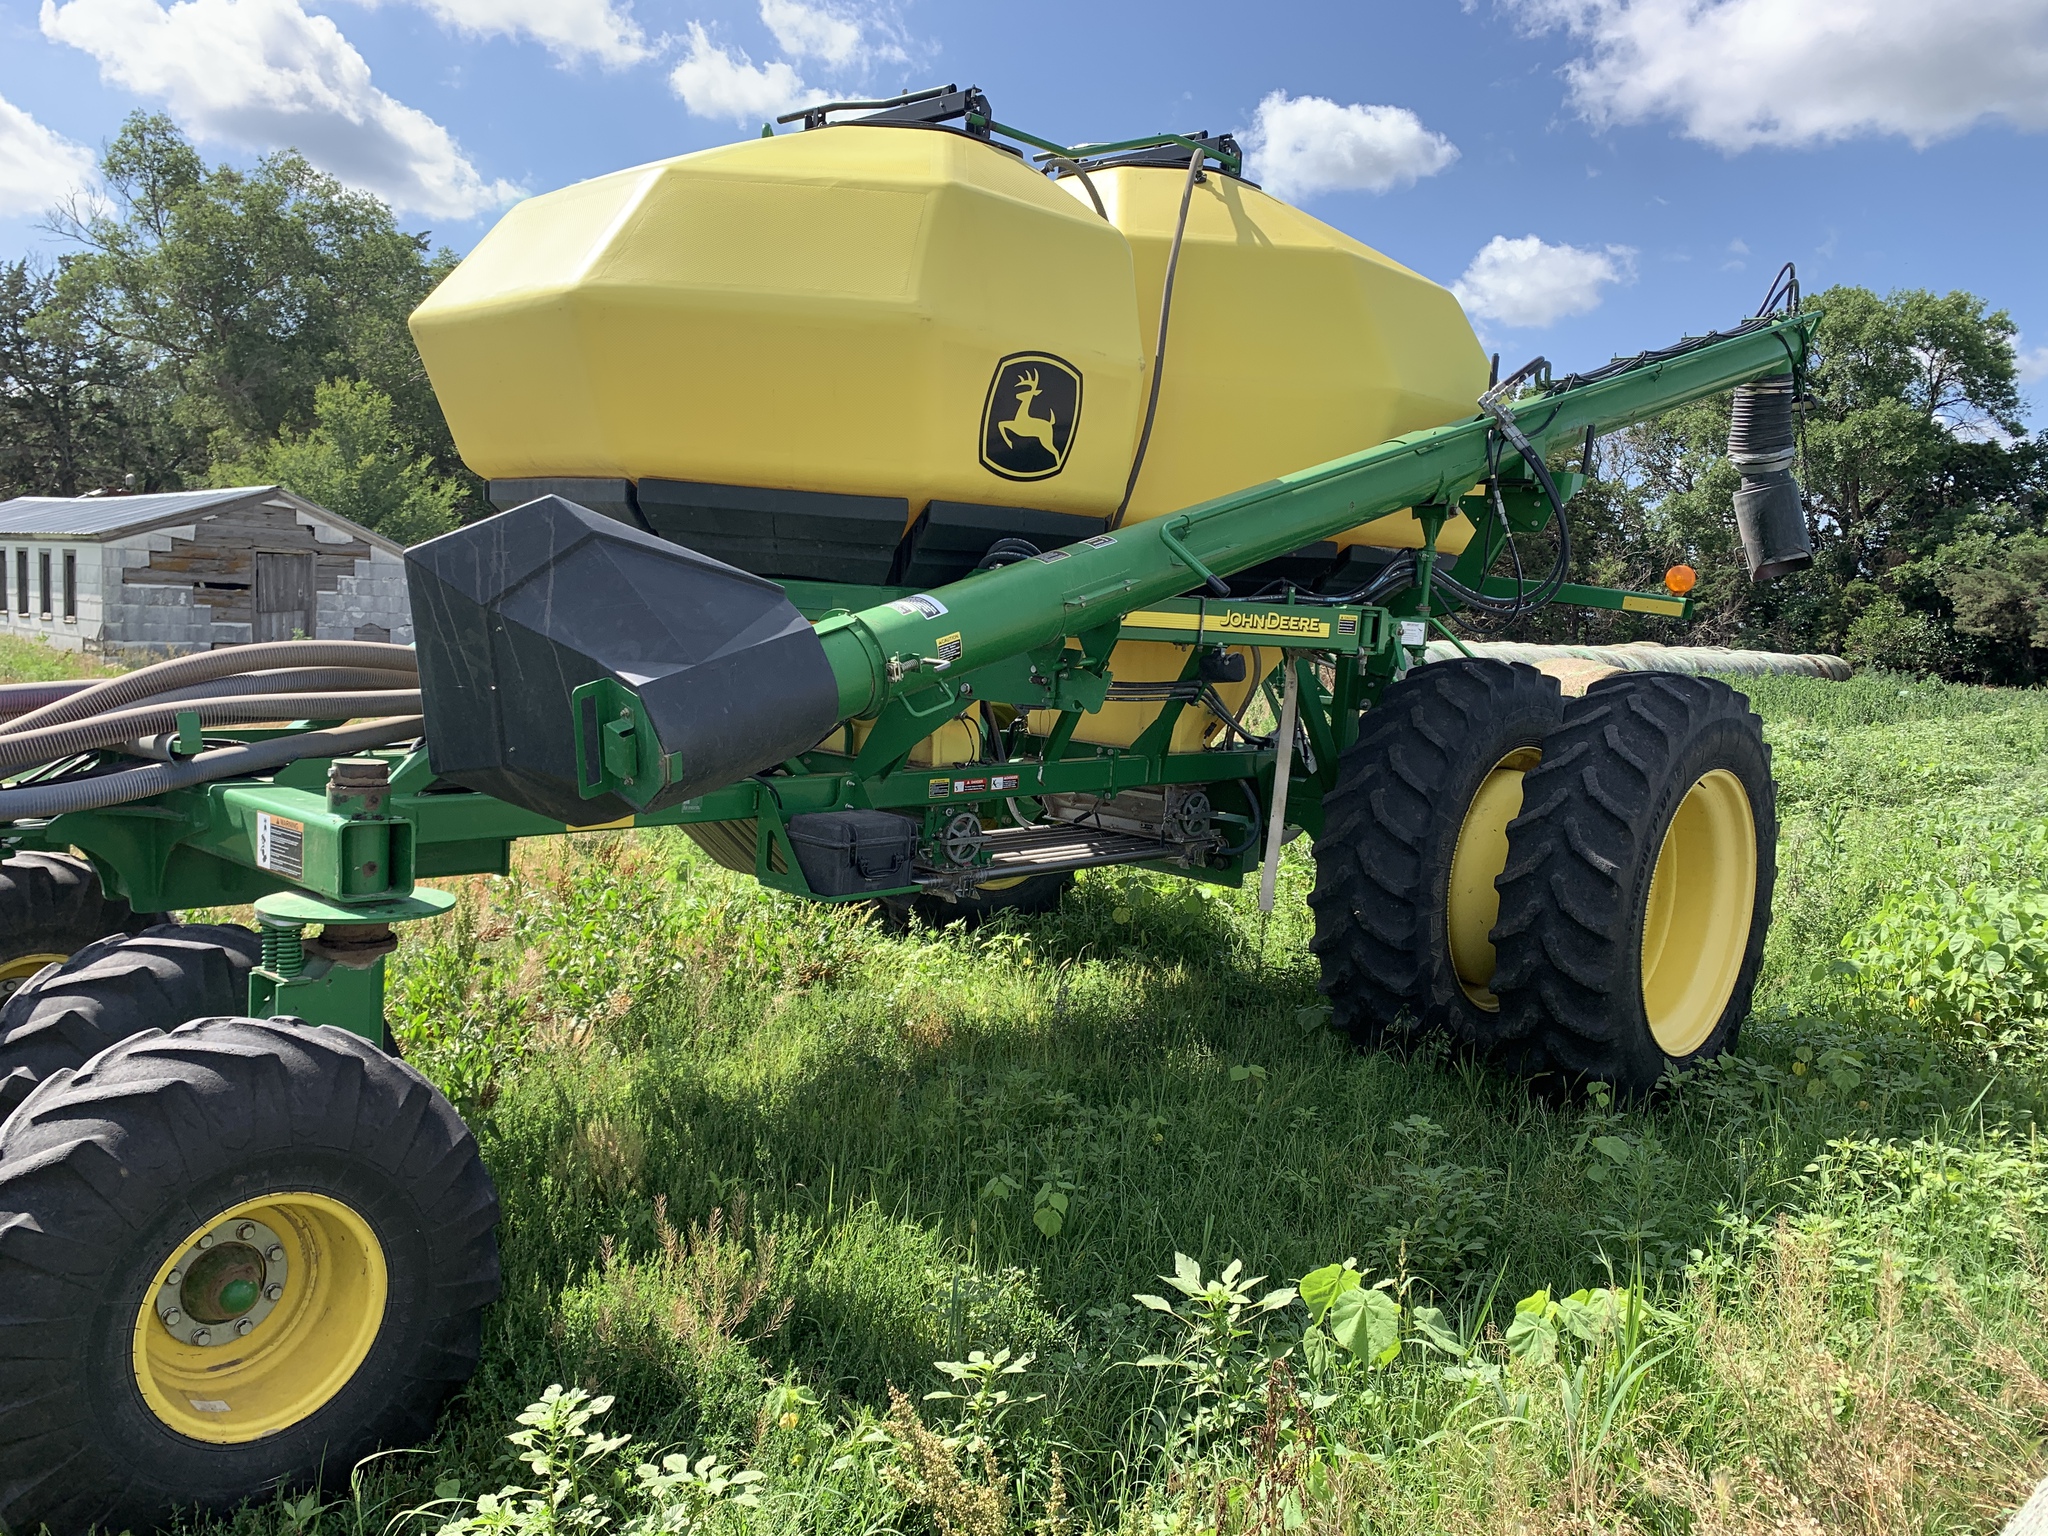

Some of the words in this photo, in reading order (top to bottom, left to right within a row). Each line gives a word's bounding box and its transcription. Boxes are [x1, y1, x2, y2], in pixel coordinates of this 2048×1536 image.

[1220, 609, 1265, 629] JOHN
[1266, 612, 1321, 632] DEERE
[941, 634, 959, 644] CAUTION
[280, 818, 299, 830] WARNING
